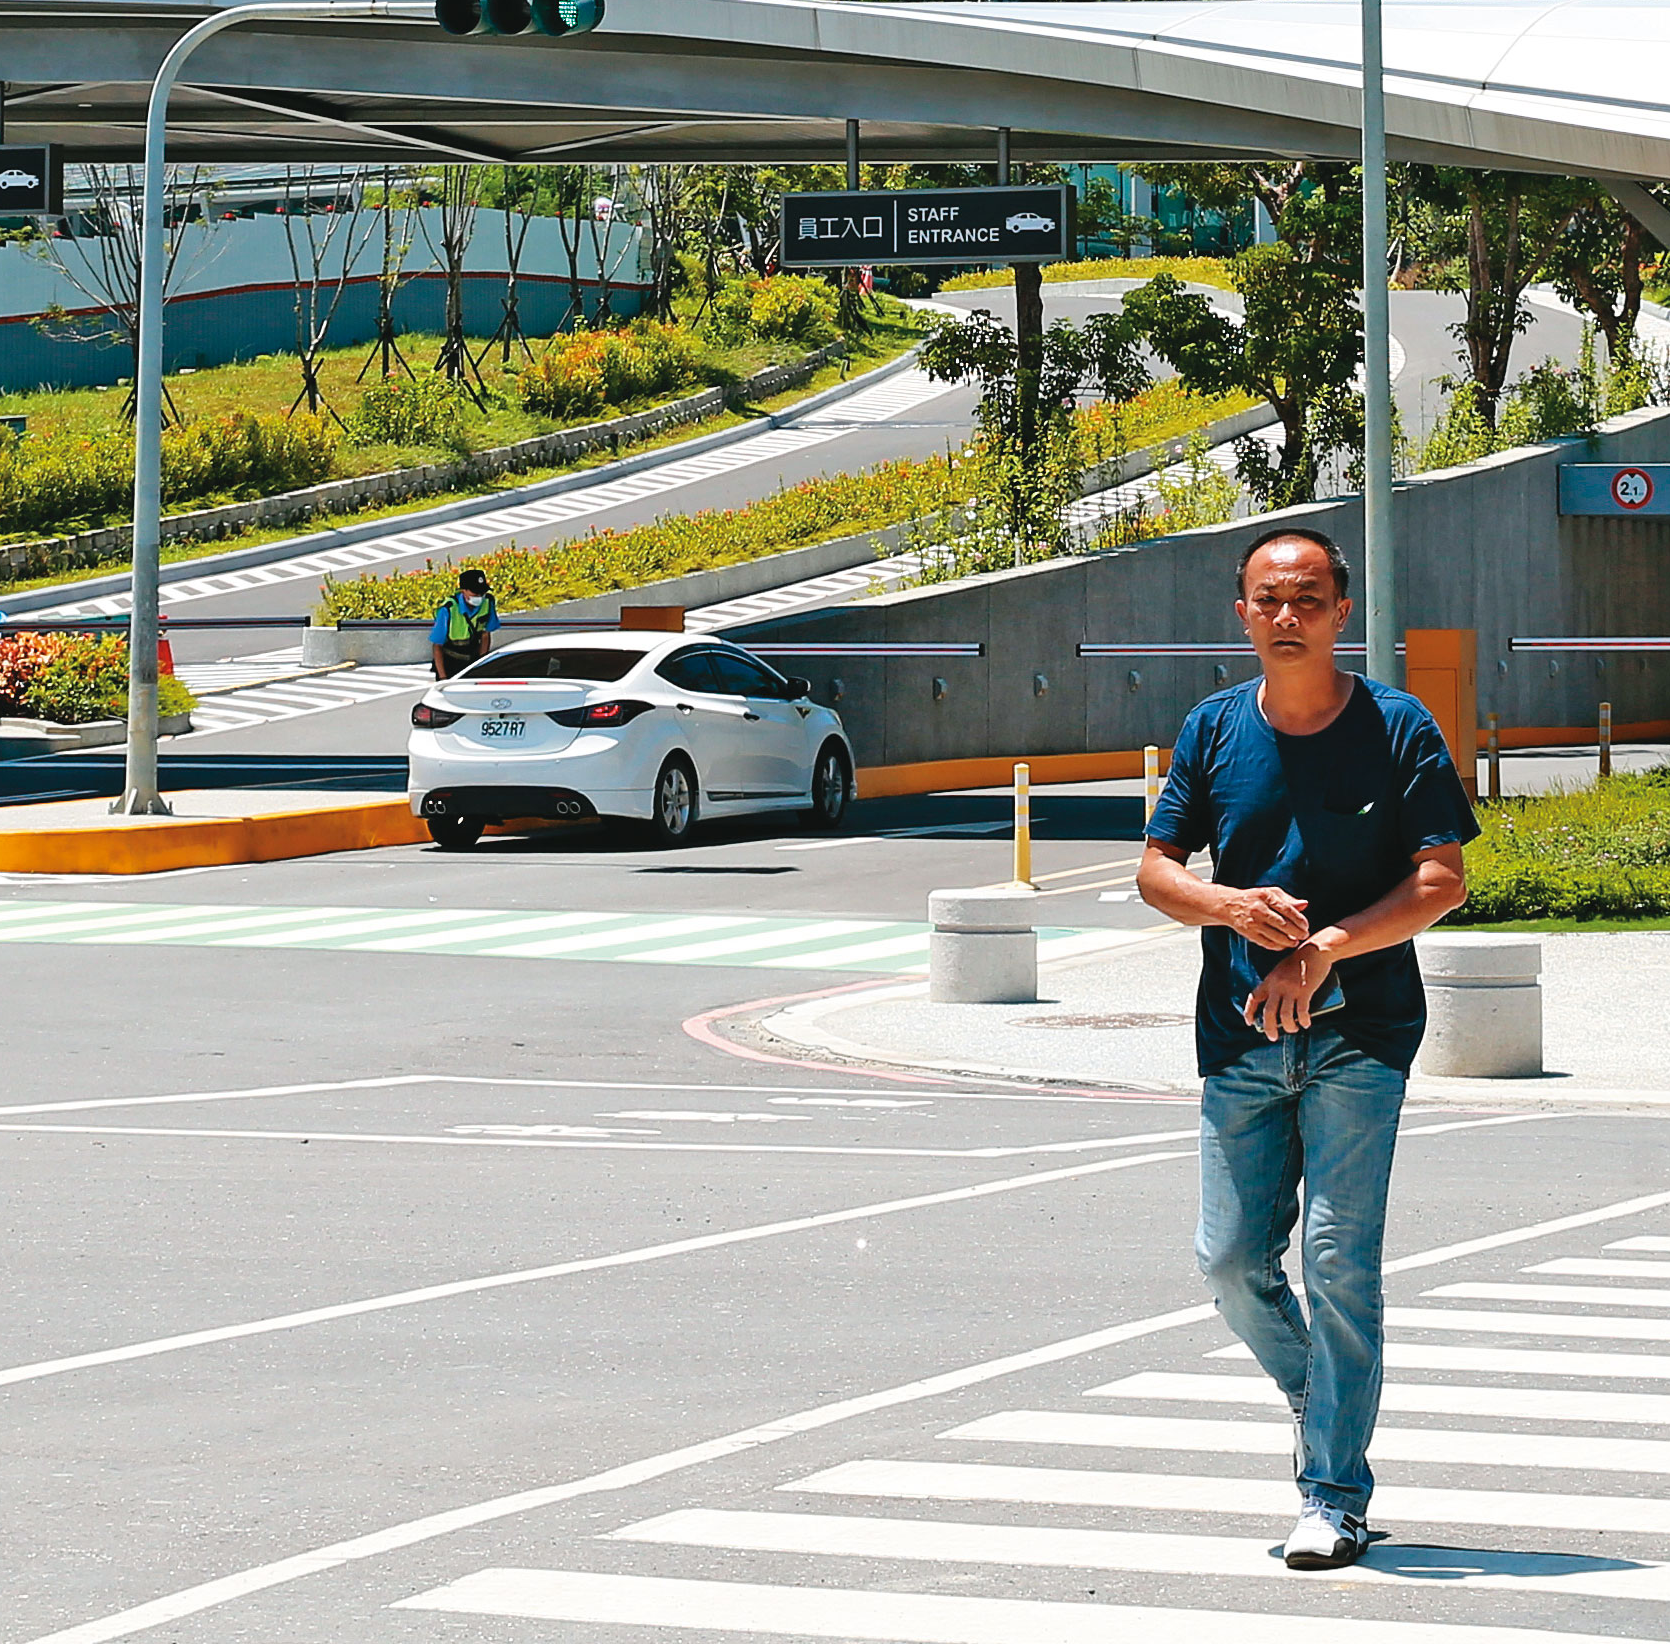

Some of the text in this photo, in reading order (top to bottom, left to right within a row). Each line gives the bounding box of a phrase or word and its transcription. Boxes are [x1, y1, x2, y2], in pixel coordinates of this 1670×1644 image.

[908, 207, 960, 222] STAFF
[798, 216, 883, 240] 員工入口
[908, 228, 1000, 244] ENTRANCE
